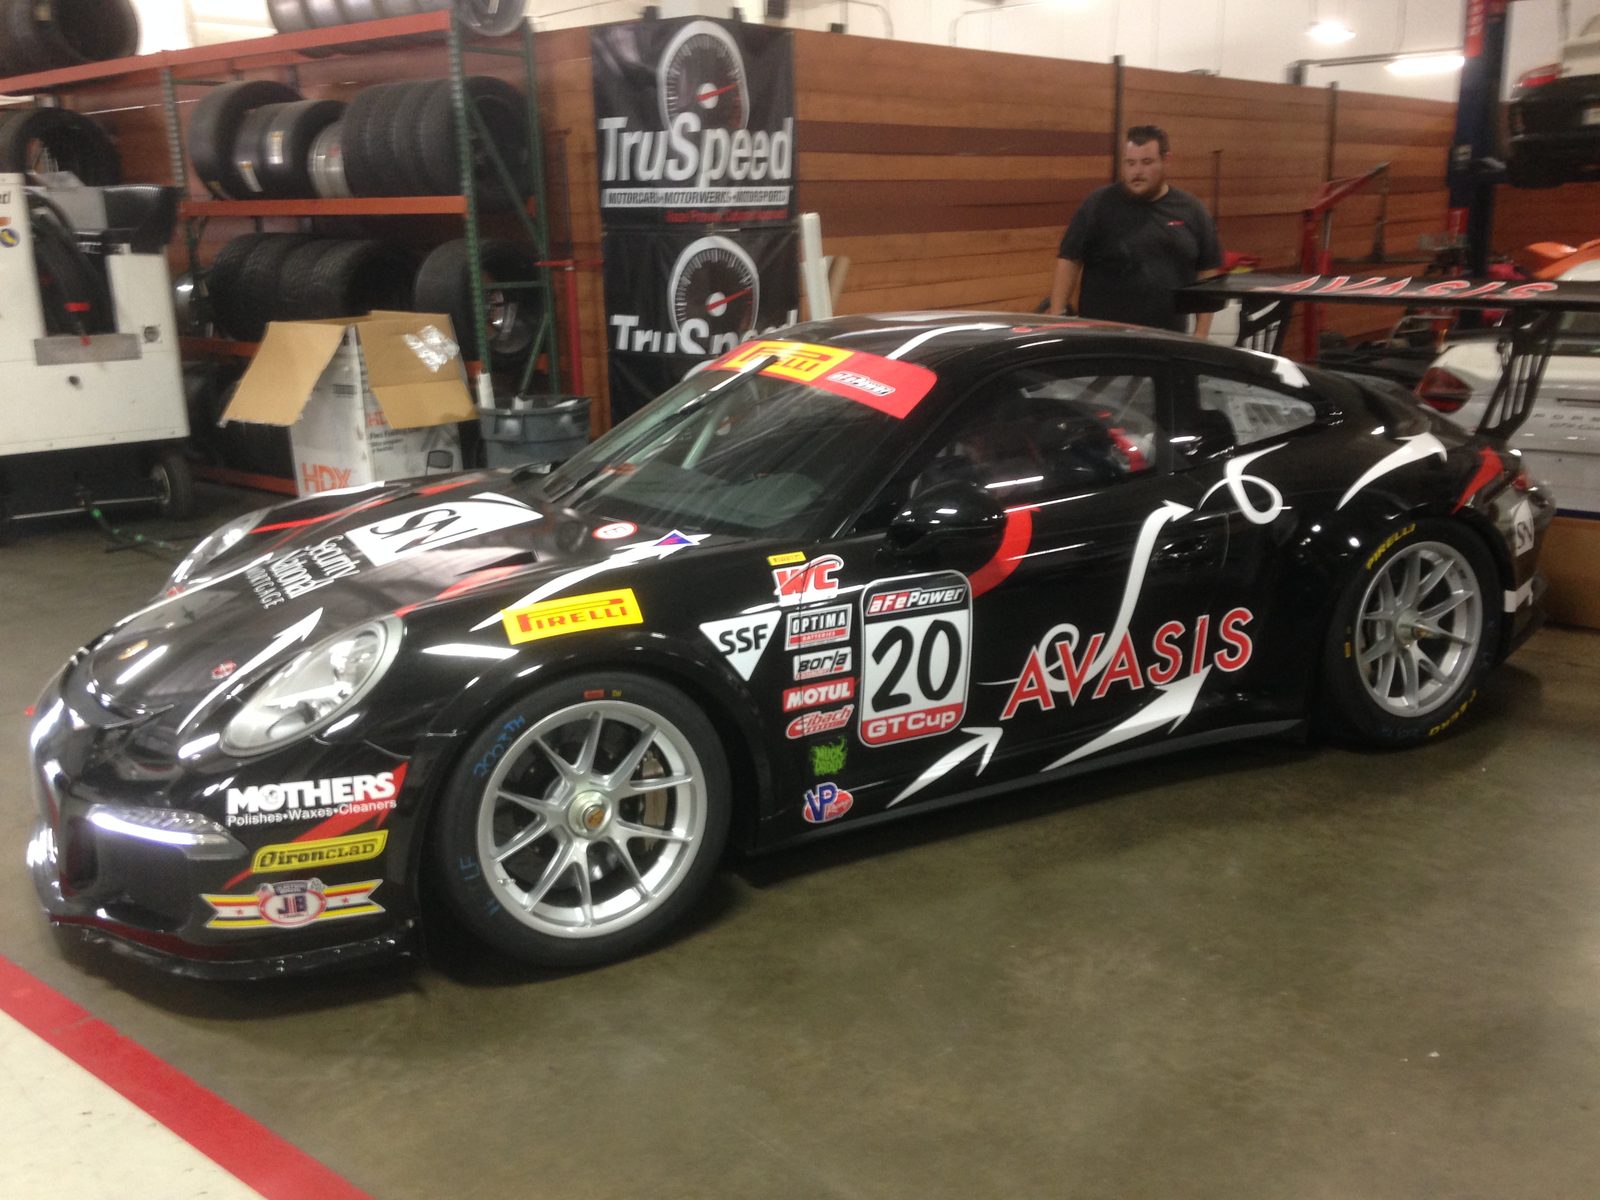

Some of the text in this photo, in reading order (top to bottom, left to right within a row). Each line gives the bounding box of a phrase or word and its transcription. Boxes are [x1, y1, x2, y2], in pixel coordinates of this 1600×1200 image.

[598, 112, 794, 187] TruSpeed
[302, 463, 351, 493] HDX
[516, 598, 628, 633] PIRELLI
[792, 611, 846, 635] OPTIMA
[719, 623, 768, 657] SSF
[872, 619, 962, 713] 20
[1000, 607, 1254, 721] AVASIS
[787, 682, 851, 709] MOTUL
[227, 772, 396, 815] MOTHERS
[806, 784, 838, 821] VP
[227, 799, 397, 827] Polishes Waxes Cleaners
